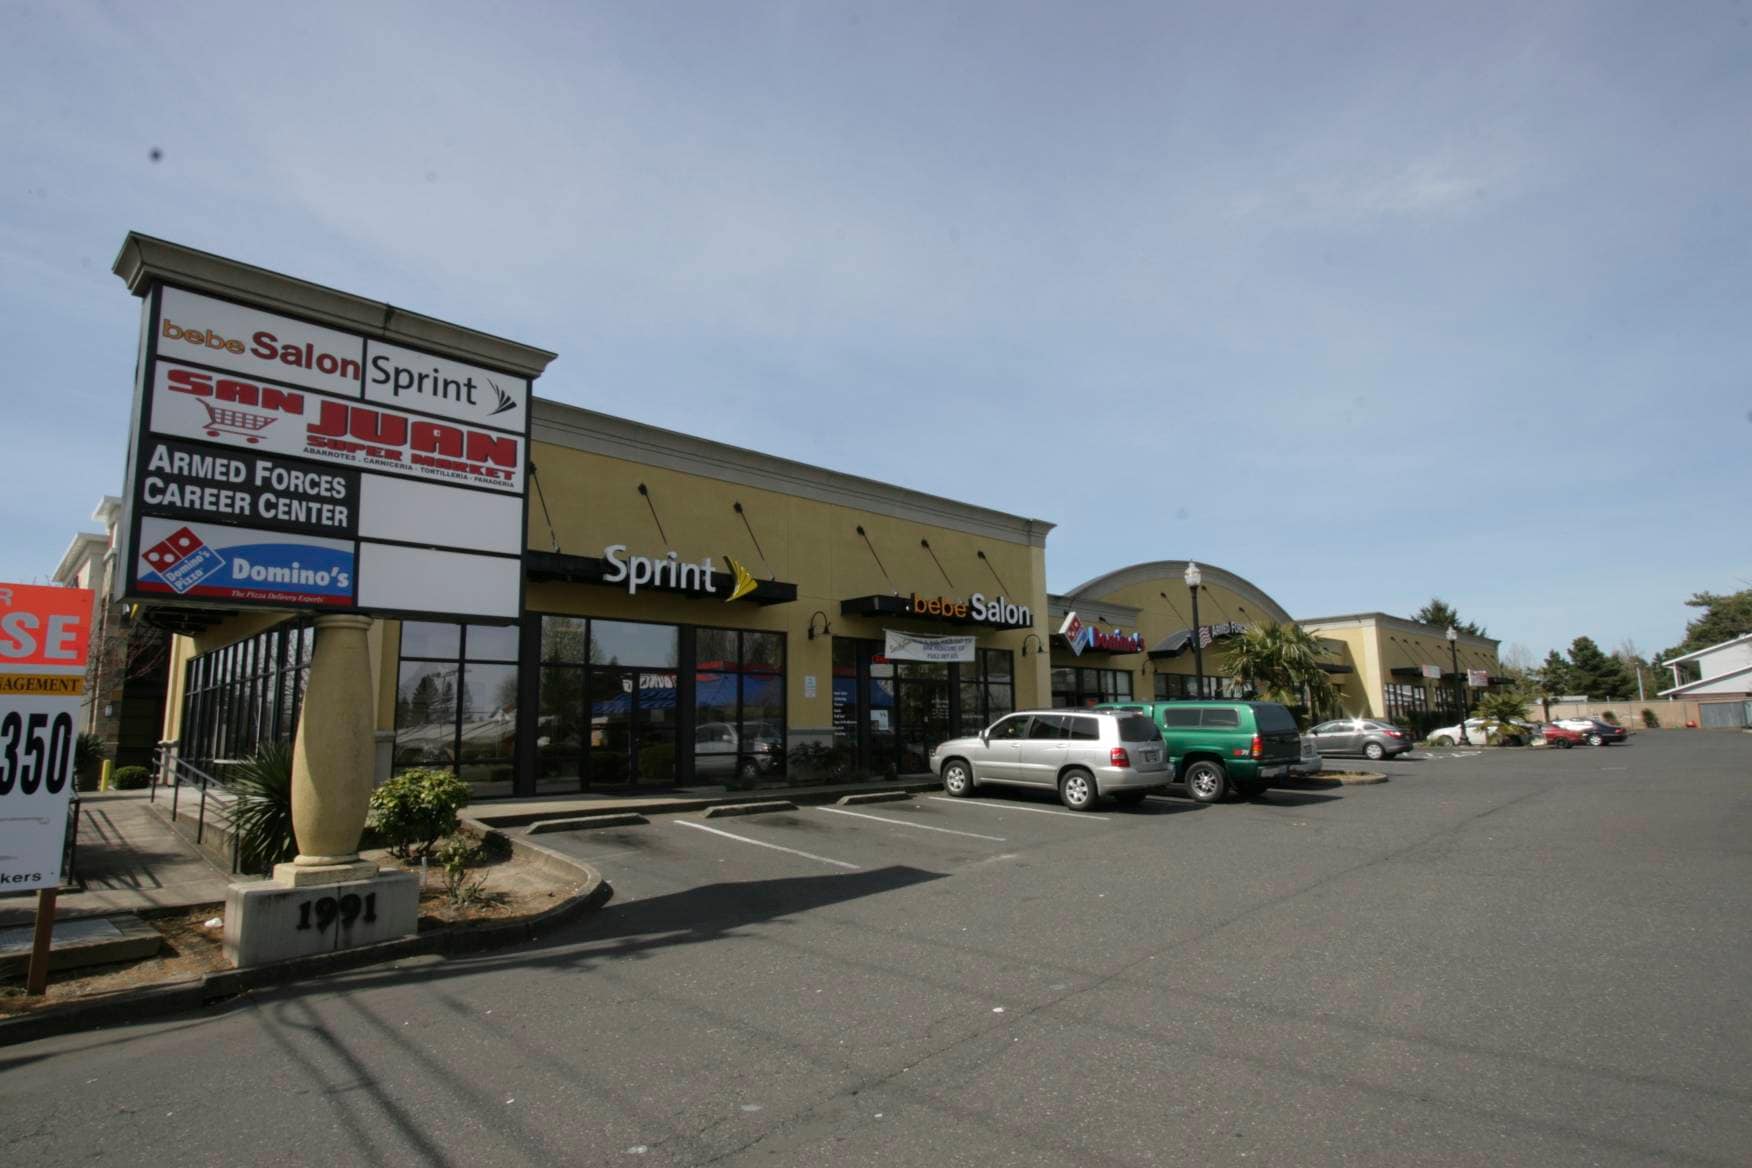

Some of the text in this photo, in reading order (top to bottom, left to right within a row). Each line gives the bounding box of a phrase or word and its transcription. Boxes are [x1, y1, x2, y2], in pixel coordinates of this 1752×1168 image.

[162, 319, 361, 381] bebe Salon
[371, 355, 477, 405] Sprint
[167, 369, 518, 468] SAN JUAN
[148, 444, 347, 499] ARMED FORCES
[307, 435, 516, 481] SUPER MARKET
[143, 477, 348, 528] CAREER CENTER
[232, 558, 350, 588] Domino's
[603, 544, 716, 594] Sprint
[913, 592, 1031, 626] bebe Salon
[296, 892, 377, 934] 1991
